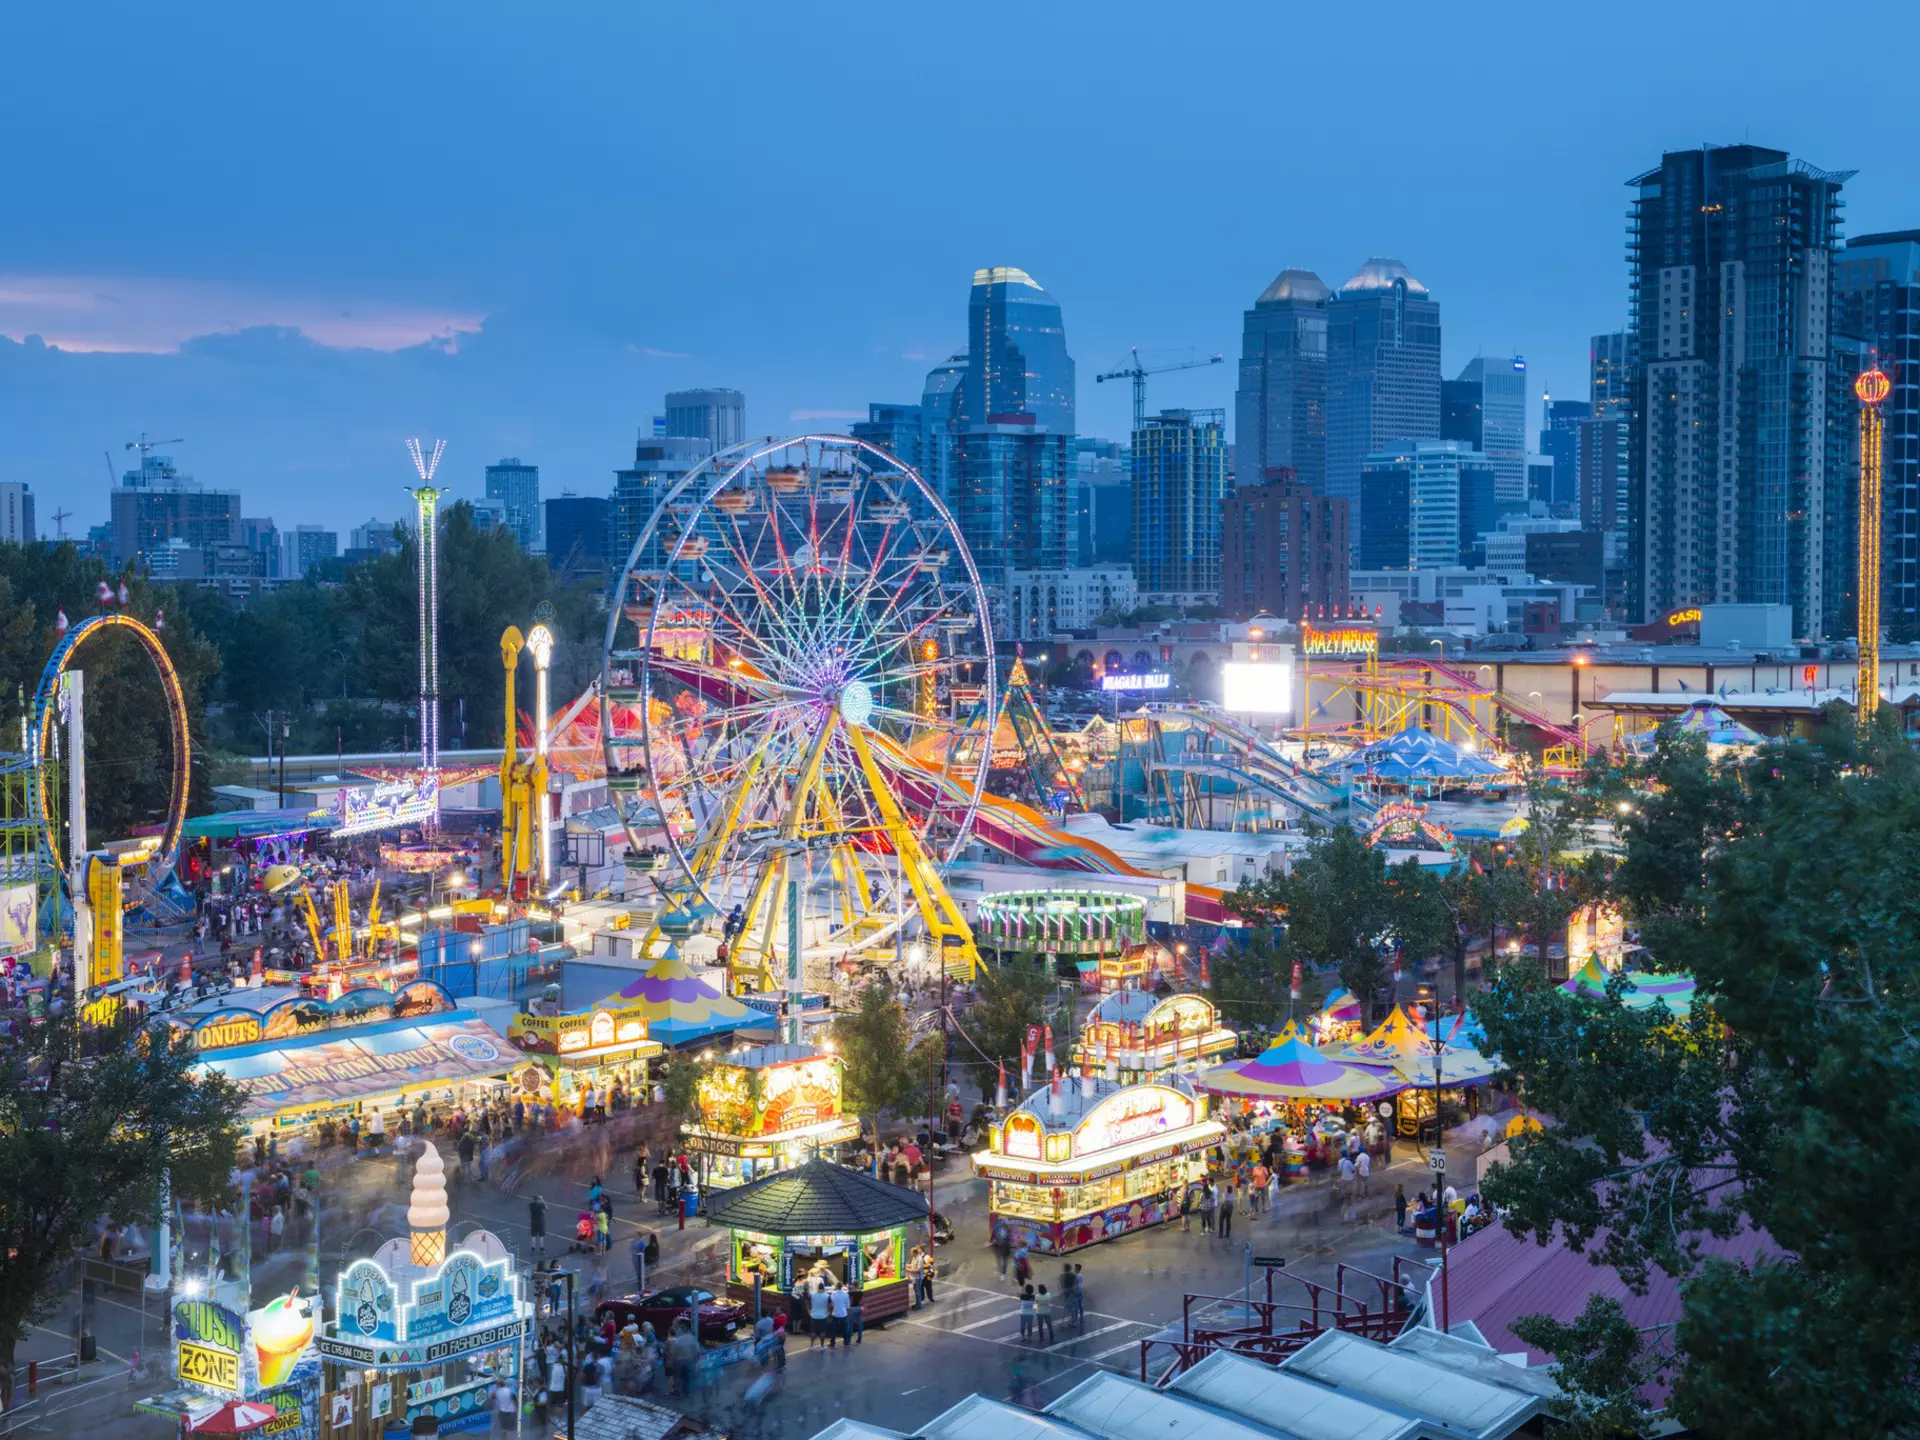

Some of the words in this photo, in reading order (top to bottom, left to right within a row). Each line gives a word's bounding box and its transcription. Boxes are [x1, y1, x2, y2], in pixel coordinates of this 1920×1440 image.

[1304, 626, 1340, 654] CRAZY
[1341, 629, 1378, 653] MOUSE
[1103, 675, 1142, 690] NIAGARA
[1145, 674, 1170, 688] FALLS
[521, 1017, 550, 1029] COFFEE
[559, 1018, 587, 1030] COFFEE
[282, 1065, 332, 1088] NOW
[329, 1055, 382, 1082] MINI
[379, 1043, 454, 1070] DONUTS
[1431, 1157, 1445, 1169] 30
[176, 1300, 241, 1354] SLUSH
[321, 1342, 330, 1353] ICE
[331, 1344, 353, 1356] CREAM
[353, 1348, 374, 1361] CONES
[430, 1343, 448, 1360] OLD
[450, 1330, 496, 1354] FASHIONED
[181, 1347, 236, 1386] ZONE
[267, 1412, 299, 1433] ZONE
